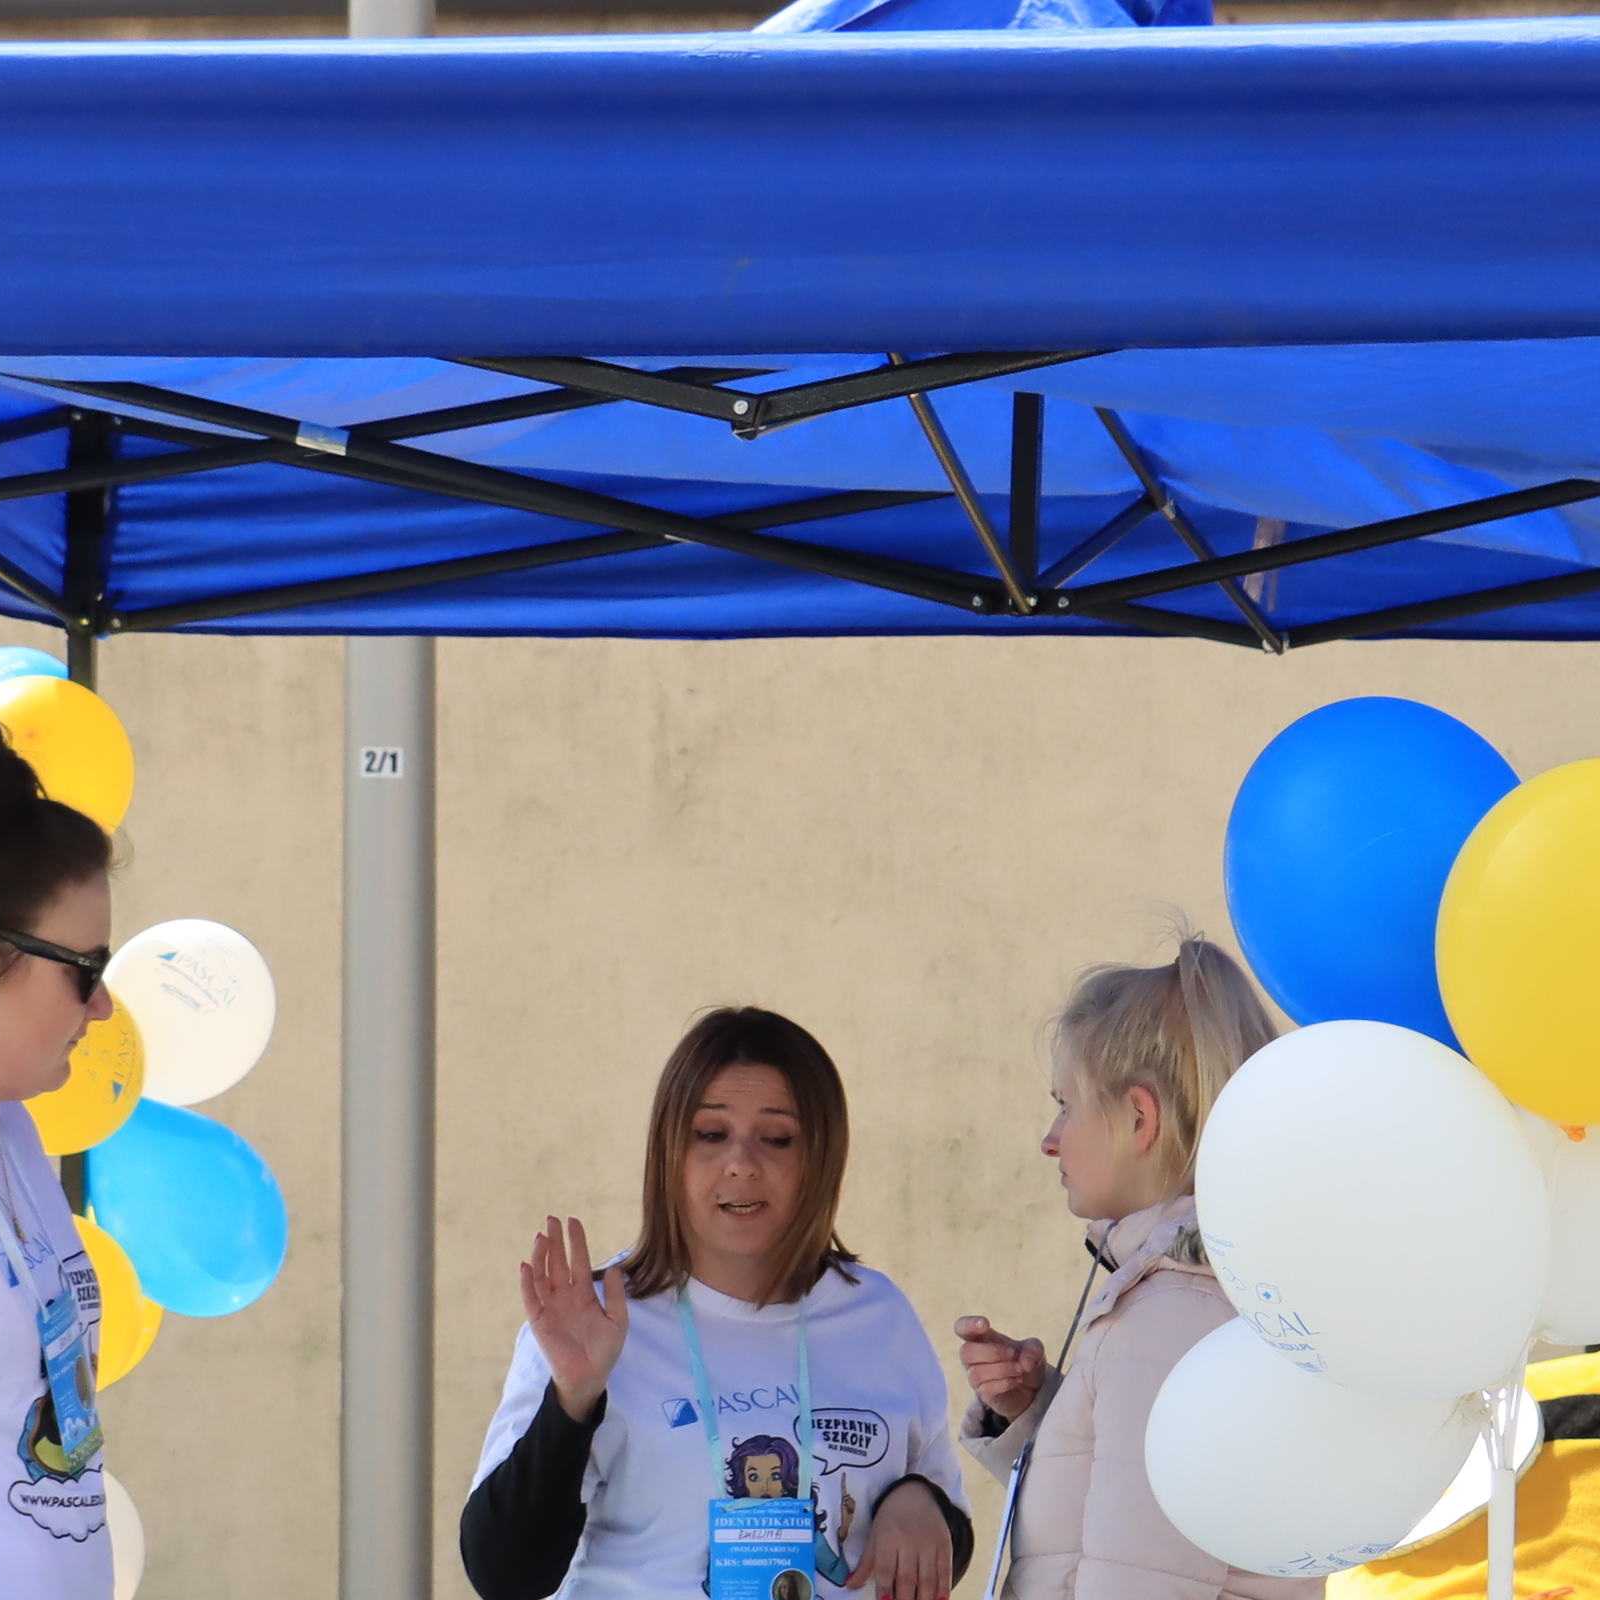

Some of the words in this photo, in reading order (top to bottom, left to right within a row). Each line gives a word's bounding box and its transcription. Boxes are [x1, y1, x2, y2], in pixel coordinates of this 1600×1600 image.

[365, 750, 398, 773] 2/1
[176, 953, 236, 1011] PASCAL
[1240, 1307, 1322, 1337] SCAL
[822, 1431, 872, 1449] SZKOŁY
[715, 1517, 812, 1527] IDENTYFIKATOR
[716, 1558, 741, 1567] KRS:
